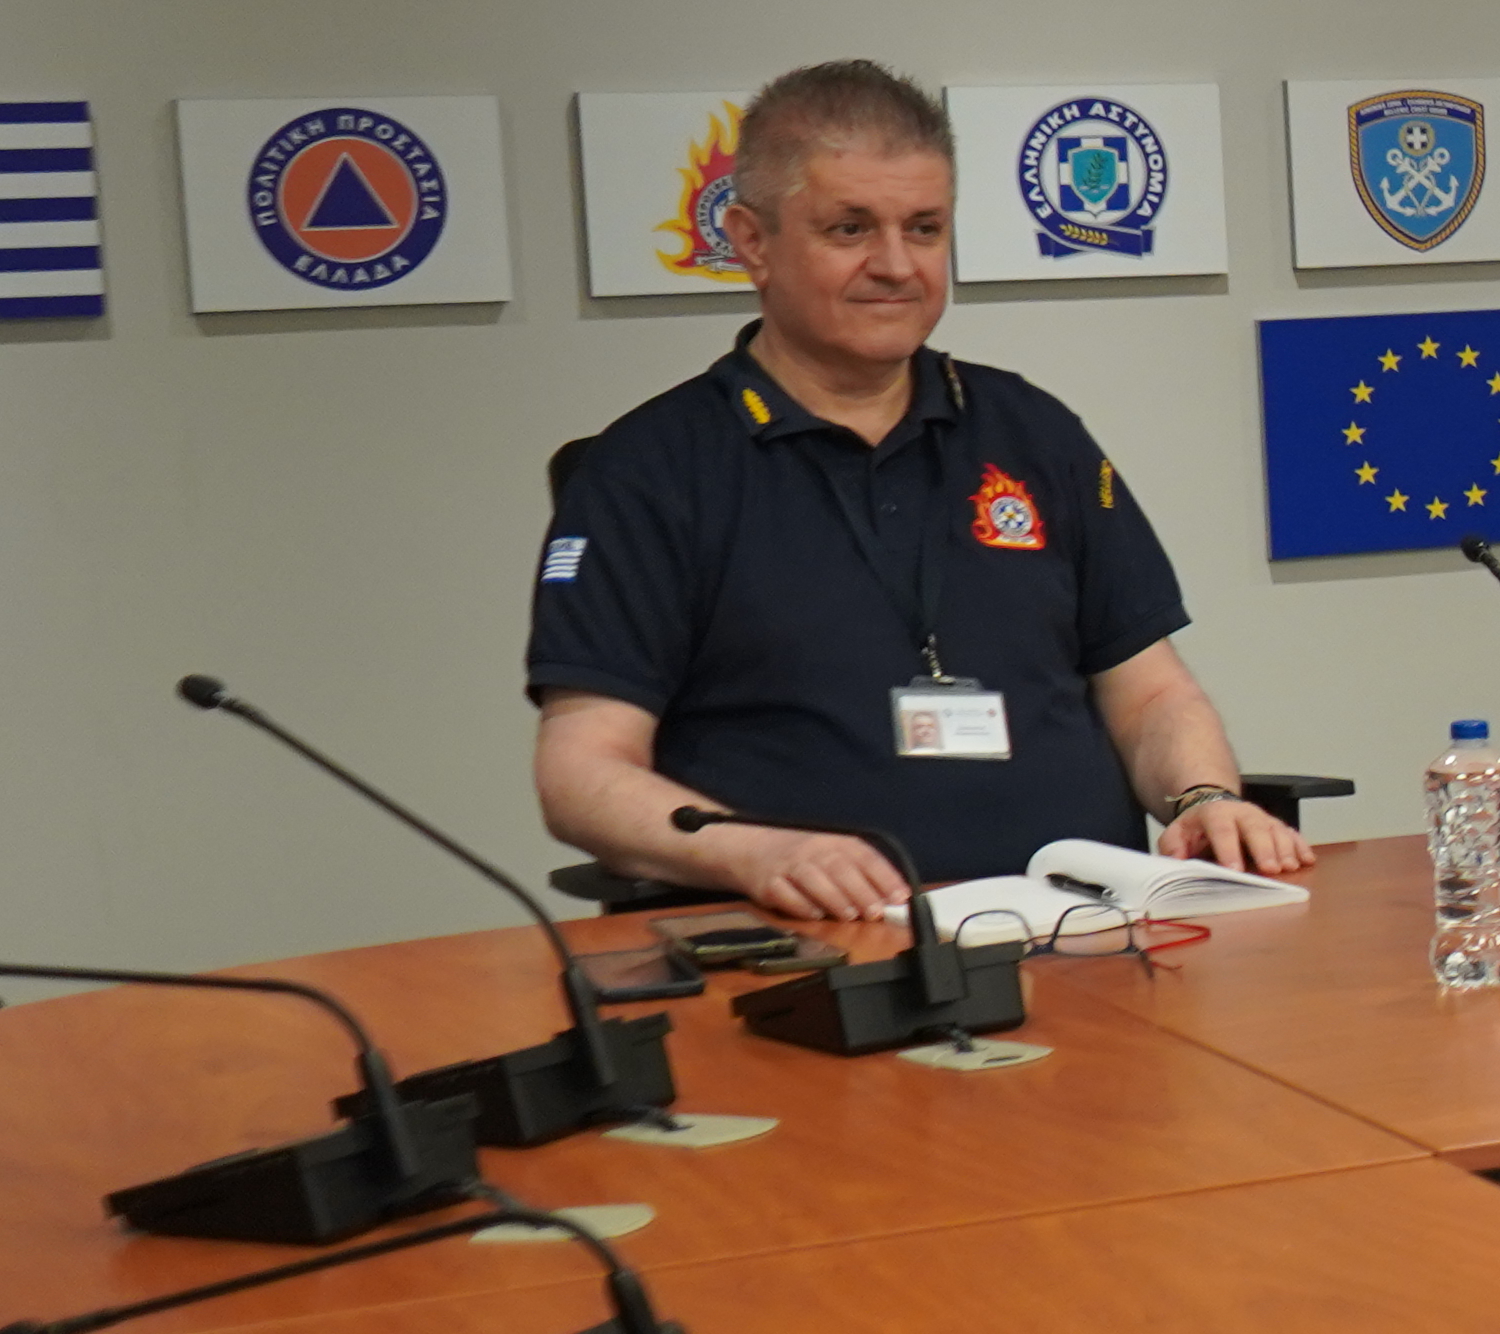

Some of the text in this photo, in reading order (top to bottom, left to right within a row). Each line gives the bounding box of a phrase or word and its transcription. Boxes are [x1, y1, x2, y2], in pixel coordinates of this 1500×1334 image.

[253, 115, 441, 227] ΠΟΛΙΤΙΚΗ ΠΡΟΣΤΑΣΙΑ
[1024, 101, 1165, 219] ΕΛΛΗΝΙΚΗ ΑΣΤΥΝΟΜΙΑ
[293, 254, 411, 284] ΕΛΛΑΔΑ
